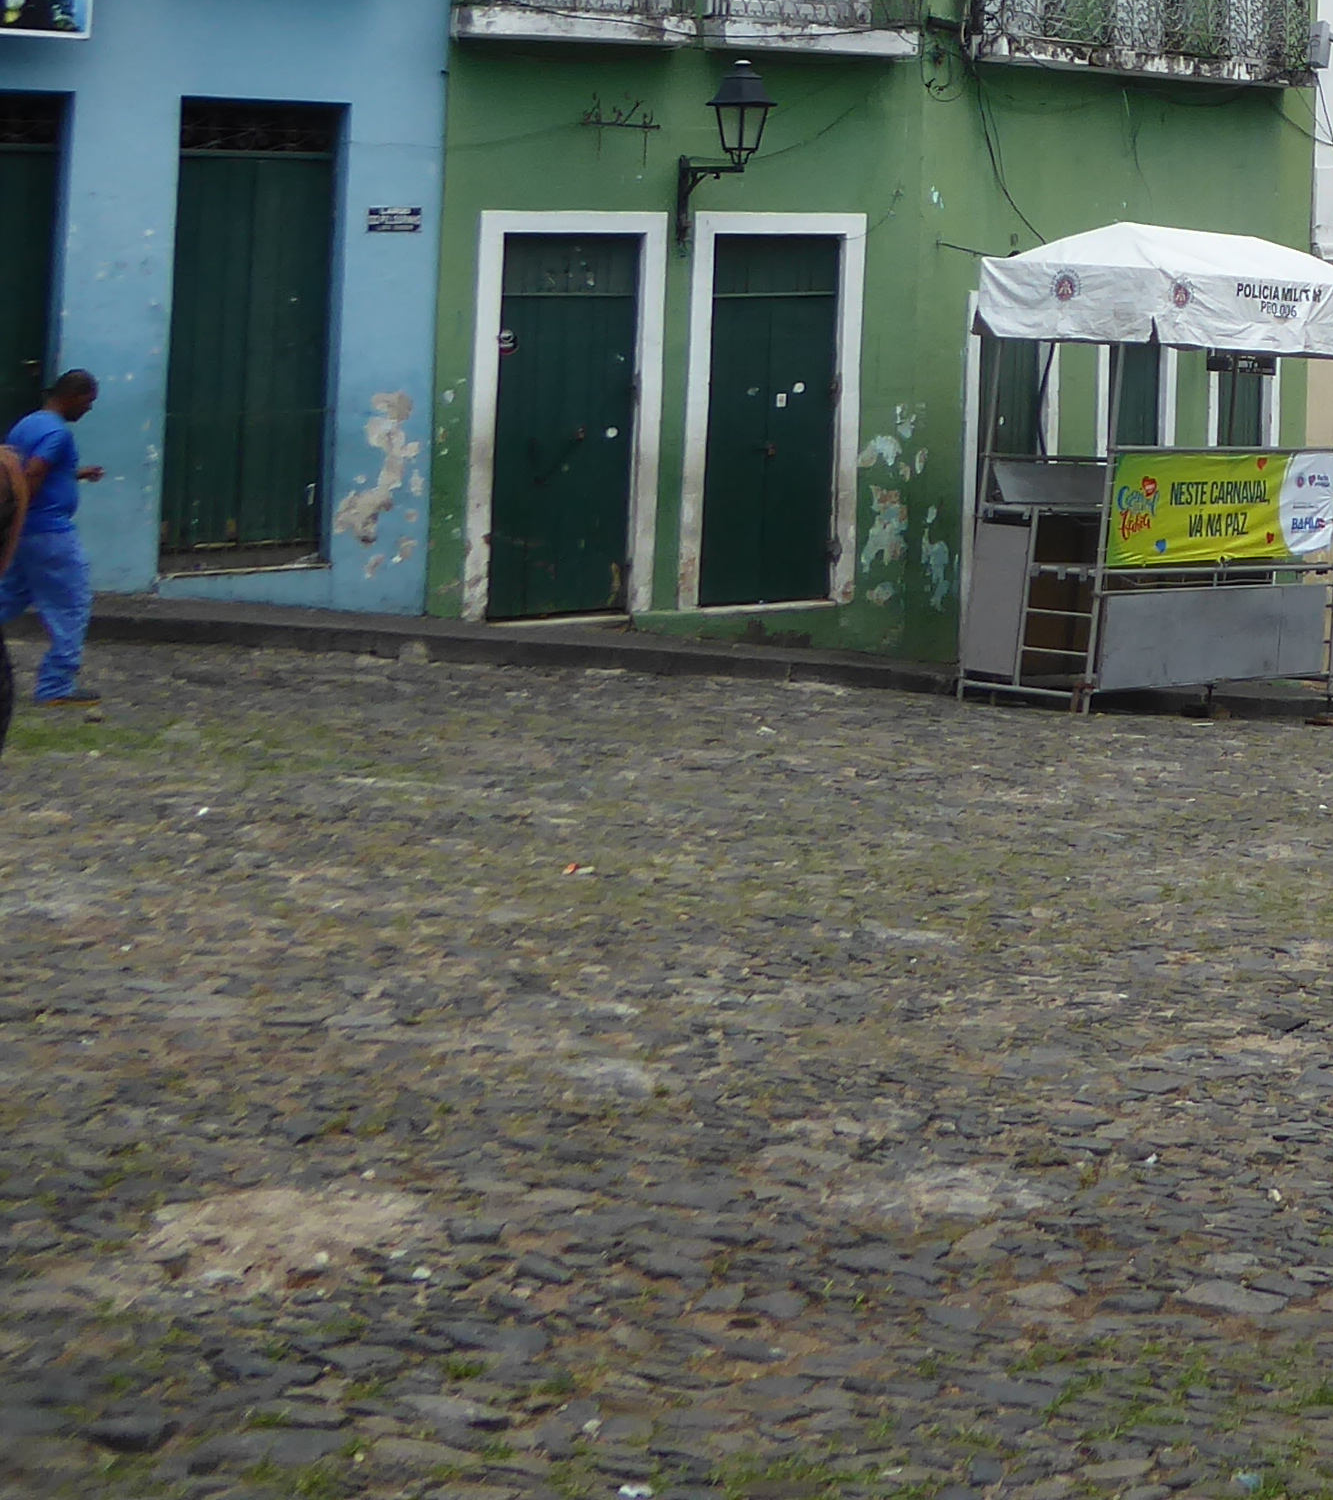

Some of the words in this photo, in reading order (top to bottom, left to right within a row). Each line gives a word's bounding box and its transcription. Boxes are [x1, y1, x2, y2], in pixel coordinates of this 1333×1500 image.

[1281, 286, 1322, 302] MILITR
[1170, 481, 1208, 506] NESTE
[1210, 480, 1270, 506] CARNAVAL,
[1188, 508, 1203, 537] VÁ
[1206, 513, 1222, 537] NA
[1225, 512, 1249, 537] PAZ
